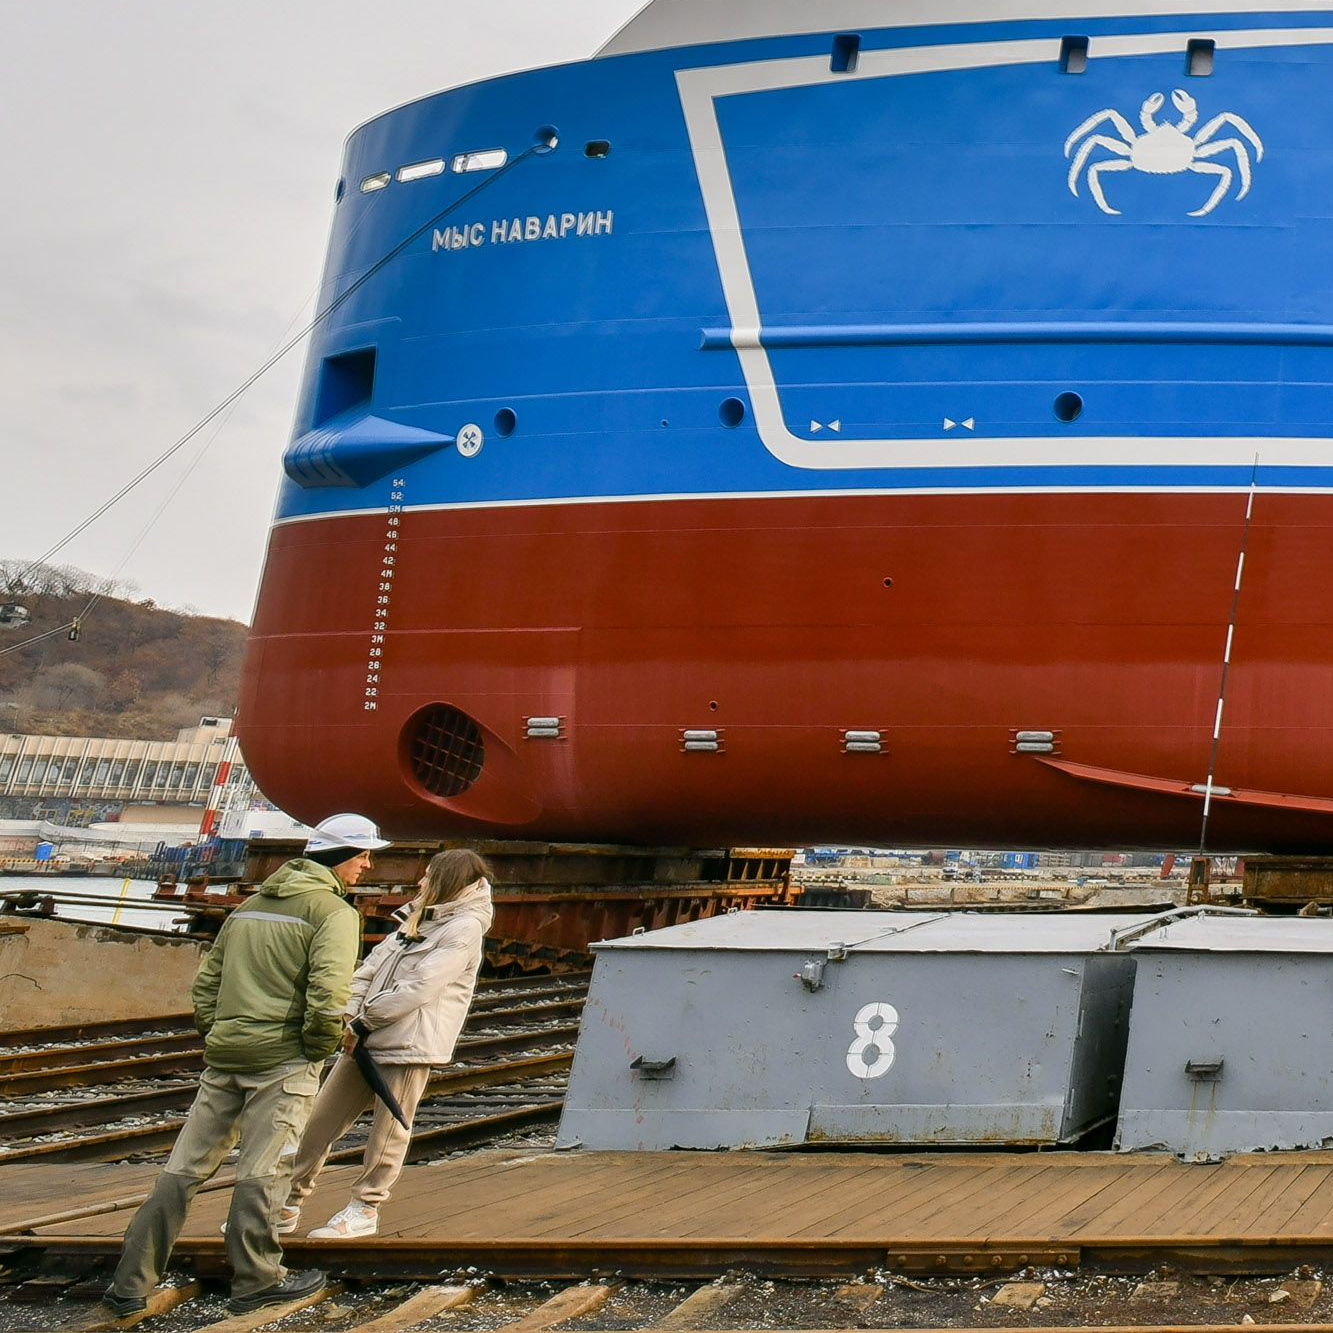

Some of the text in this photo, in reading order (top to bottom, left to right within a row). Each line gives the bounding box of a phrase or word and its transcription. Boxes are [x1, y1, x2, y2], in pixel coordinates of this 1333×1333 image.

[431, 209, 613, 251] МЫС НАВАРИН
[392, 478, 404, 487] 54
[391, 491, 403, 500] 52
[387, 517, 399, 526] 48
[386, 530, 397, 539] 46
[384, 543, 396, 552] 44
[382, 556, 394, 565] 42
[380, 569, 393, 578] 4M
[379, 582, 390, 591] 38
[377, 596, 389, 604] 36
[375, 609, 387, 617] 34
[374, 622, 385, 630] 32
[371, 635, 384, 643] 3M
[369, 648, 381, 656] 28
[368, 661, 380, 670] 26
[366, 674, 378, 683] 24
[365, 687, 377, 696] 22
[364, 701, 377, 710] 2M
[846, 1002, 898, 1078] 8
